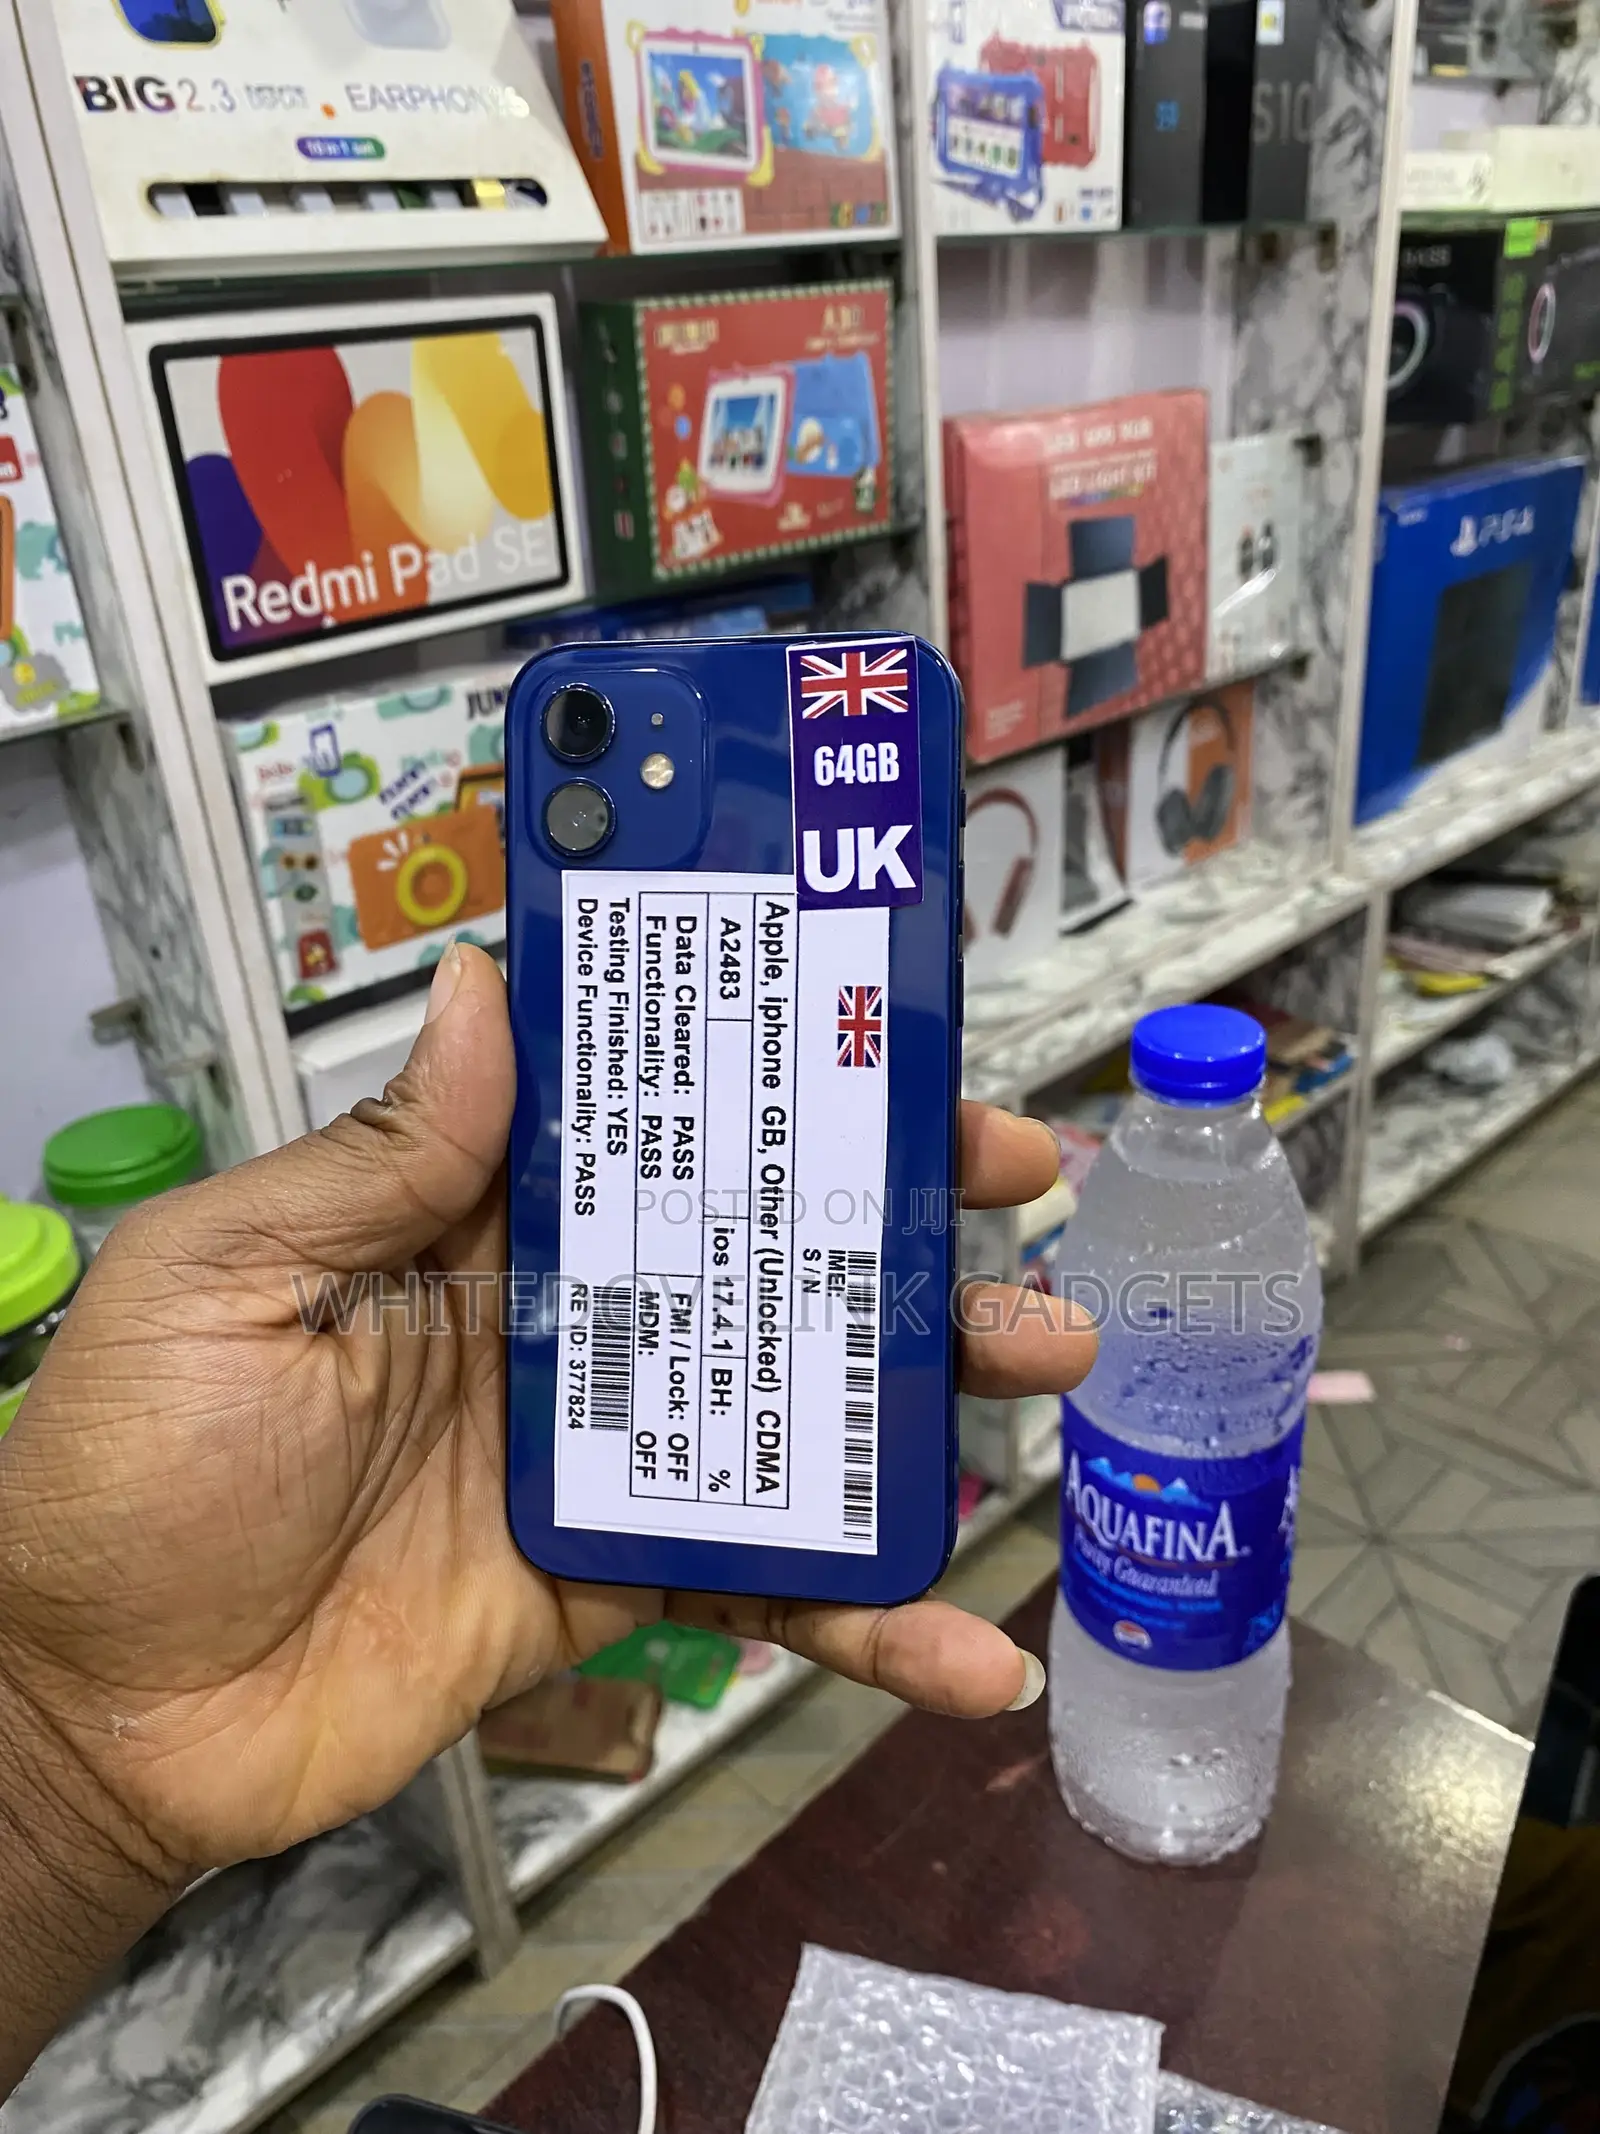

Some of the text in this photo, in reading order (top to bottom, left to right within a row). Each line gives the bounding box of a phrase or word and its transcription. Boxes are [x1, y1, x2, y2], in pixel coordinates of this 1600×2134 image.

[220, 521, 550, 633] Redmi Pad SE
[814, 742, 900, 787] 64GB
[802, 824, 917, 893] UK
[719, 916, 742, 1000] A2483
[570, 898, 599, 1216] Device Functionality: PASS
[603, 897, 631, 1156] Testing Finished: YES
[639, 915, 667, 1180] Functionality: PASS
[672, 915, 698, 1181] Data Cleared: PASS
[750, 900, 790, 1494] Apple, iphone GB, Other (Unlocked) CDMA
[711, 1227, 736, 1351] ios 17.4.1
[802, 1248, 822, 1262] S
[802, 1279, 821, 1294] N
[827, 1249, 847, 1298] IMEI:
[669, 1293, 693, 1335] FMI
[568, 1283, 589, 1430] RE ID: 377824
[634, 1291, 660, 1480] MDM: OFF
[668, 1355, 691, 1420] Lock:
[710, 1368, 733, 1416] BH:
[667, 1432, 690, 1482] OFF
[708, 1469, 731, 1493] %
[1065, 1450, 1239, 1562] AQUAFINA
